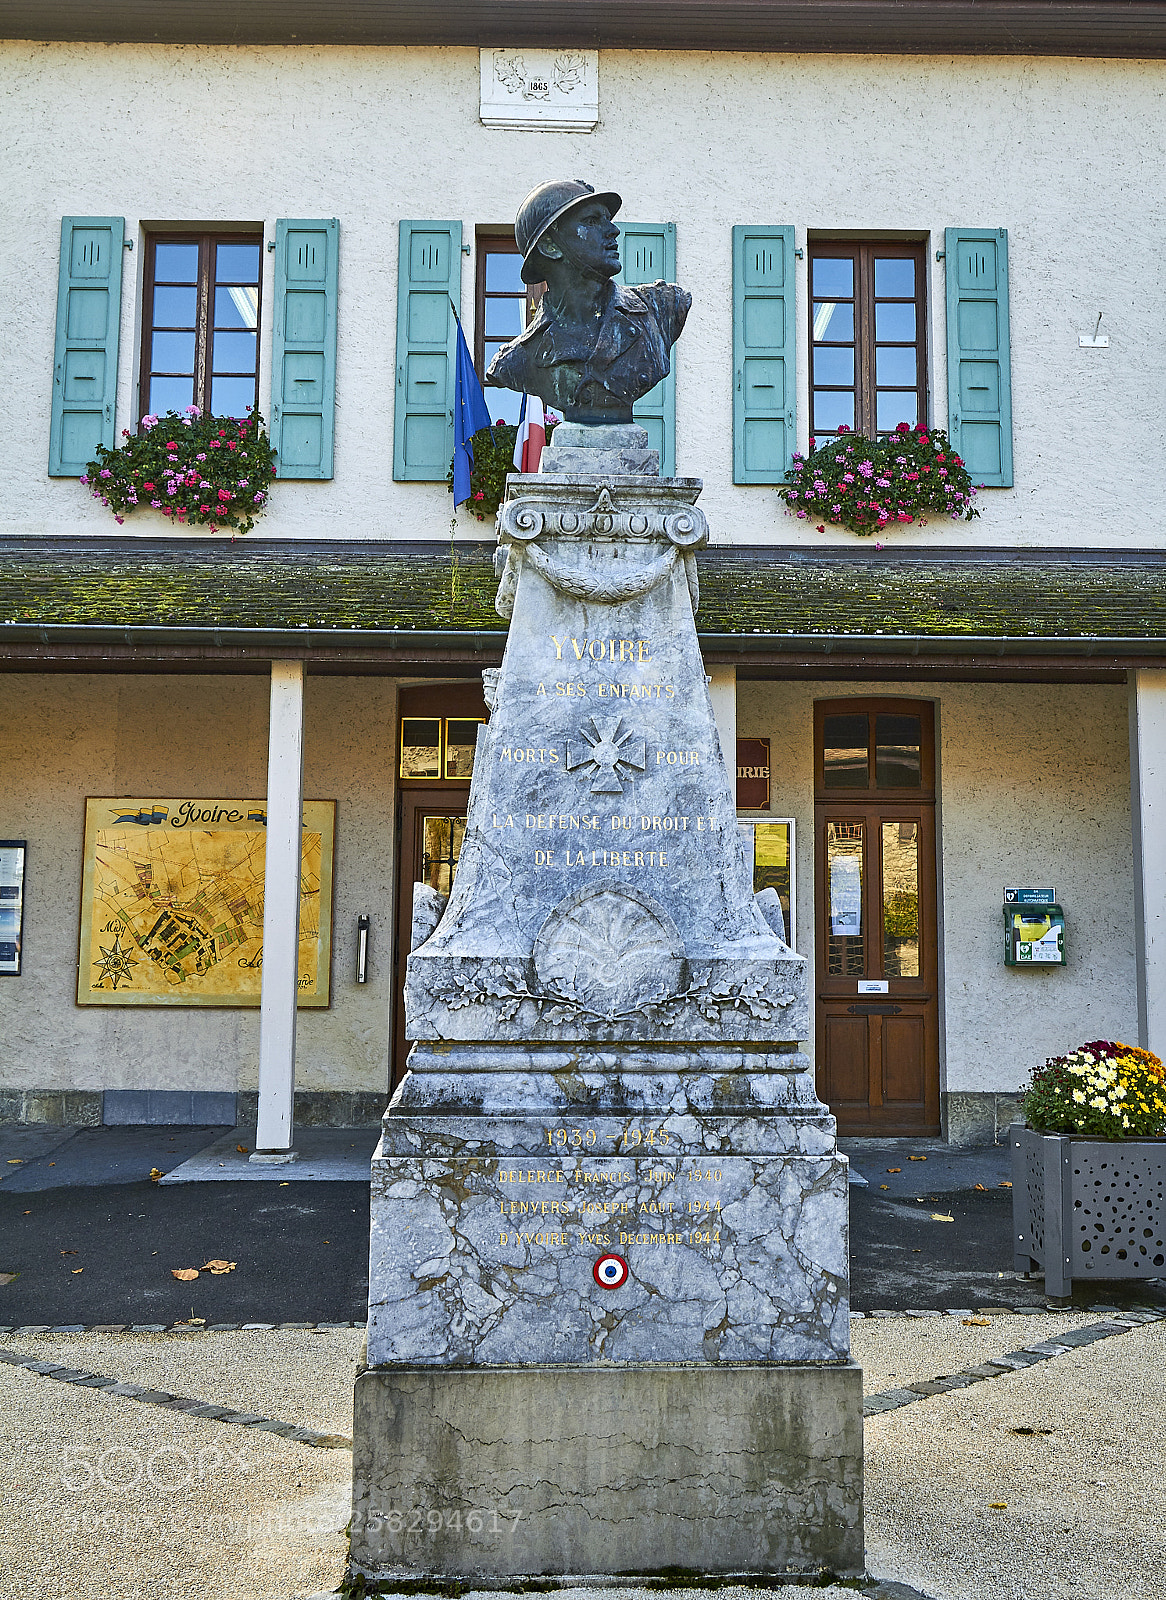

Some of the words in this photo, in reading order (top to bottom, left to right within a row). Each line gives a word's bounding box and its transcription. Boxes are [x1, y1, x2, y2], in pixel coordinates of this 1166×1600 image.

[530, 82, 548, 91] 1865
[548, 635, 653, 663] YVOIRE
[536, 682, 547, 696] A
[555, 682, 587, 697] SES
[598, 683, 675, 698] ENFANTS
[499, 748, 559, 763] MORTS
[656, 751, 700, 765] POUR
[736, 766, 770, 778] IRIE
[492, 814, 515, 829] LA
[526, 814, 602, 830] DEFENSE
[611, 816, 632, 830] DU
[641, 816, 690, 831] DROIT
[697, 816, 717, 831] ET
[535, 850, 555, 866] DE
[566, 851, 586, 866] LA
[592, 851, 669, 867] LIBERTE
[547, 1128, 597, 1146] 1939
[623, 1129, 670, 1147] 1945
[499, 1170, 564, 1183] DELERCE
[575, 1170, 631, 1183] FRANCIS
[644, 1169, 676, 1182] JUIN
[688, 1169, 722, 1182] 1940
[500, 1201, 570, 1214] LENVERS
[578, 1201, 628, 1214] JOSEPH
[688, 1200, 722, 1213] 1944
[499, 1231, 569, 1246] D'YVOIRE
[578, 1231, 611, 1245] YVES
[619, 1231, 683, 1245] DECEMBRE
[689, 1231, 721, 1244] 1944
